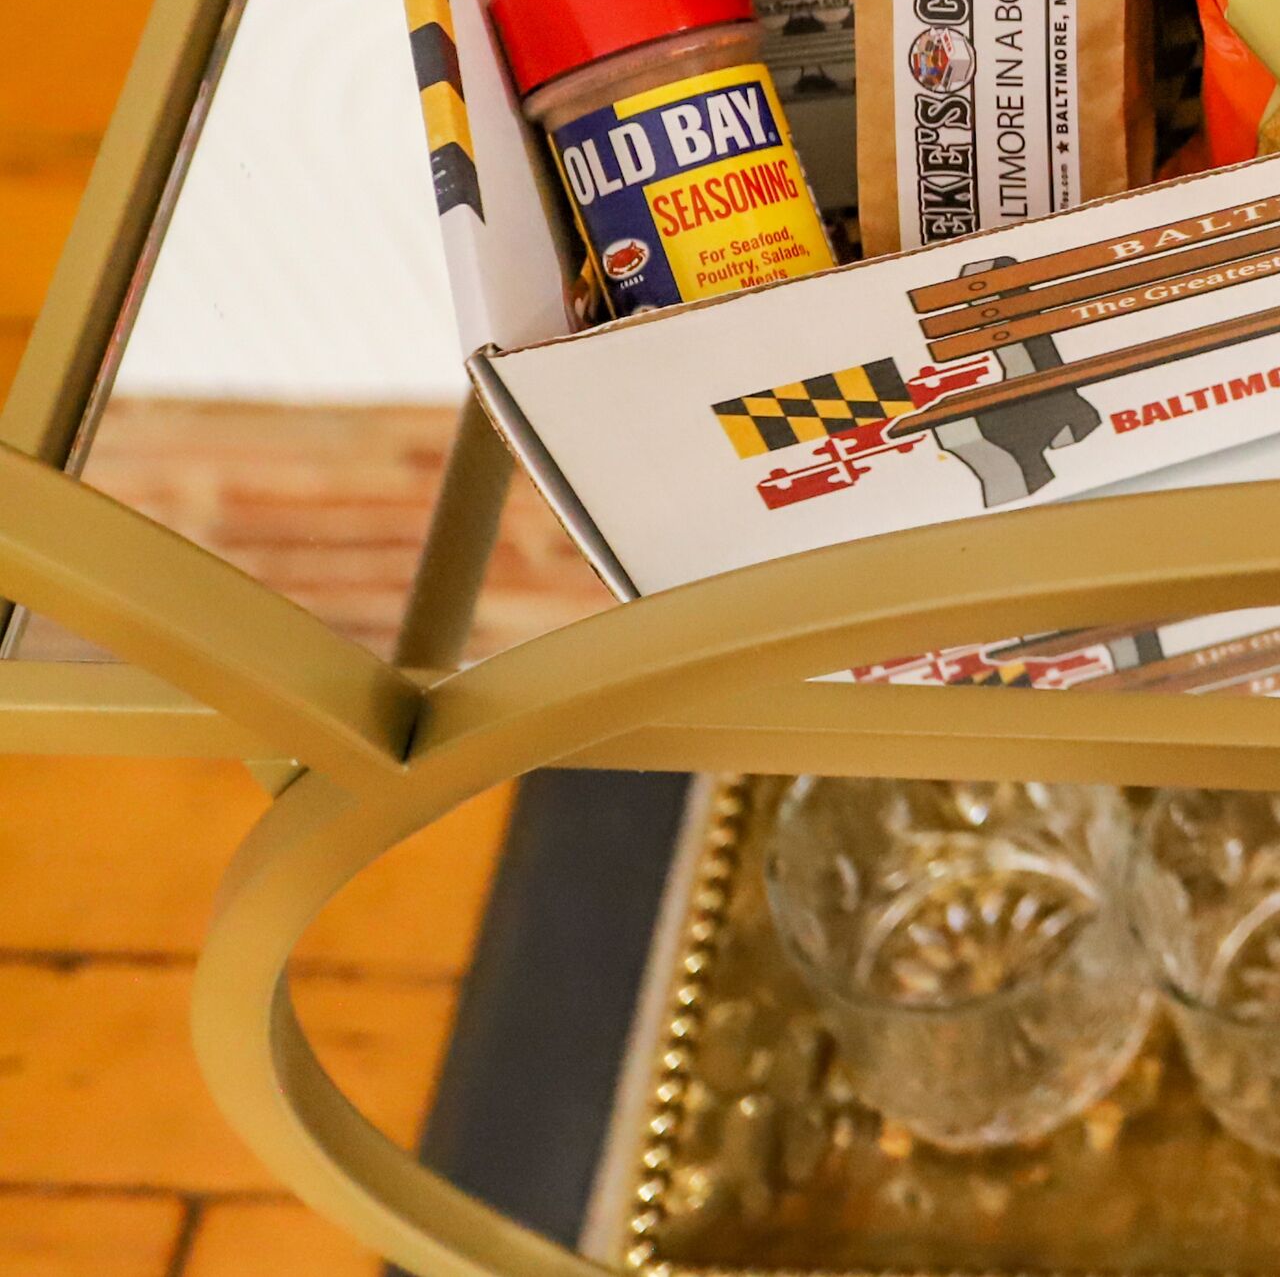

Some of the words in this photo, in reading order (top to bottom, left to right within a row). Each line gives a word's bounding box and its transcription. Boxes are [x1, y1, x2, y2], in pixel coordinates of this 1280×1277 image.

[997, 29, 1024, 52] A
[996, 58, 1025, 89] IN
[1055, 15, 1070, 133] BALTIMORE,
[562, 122, 657, 207] OLD
[660, 87, 771, 168] BAY
[916, 94, 979, 246] EKE'S
[997, 96, 1027, 218] LTIMORE
[653, 159, 799, 238] SEASONING
[696, 259, 759, 288] Poultry,
[761, 243, 811, 266] Salads,
[698, 248, 726, 266] For
[730, 226, 794, 255] Seafood,
[1071, 293, 1136, 322] The
